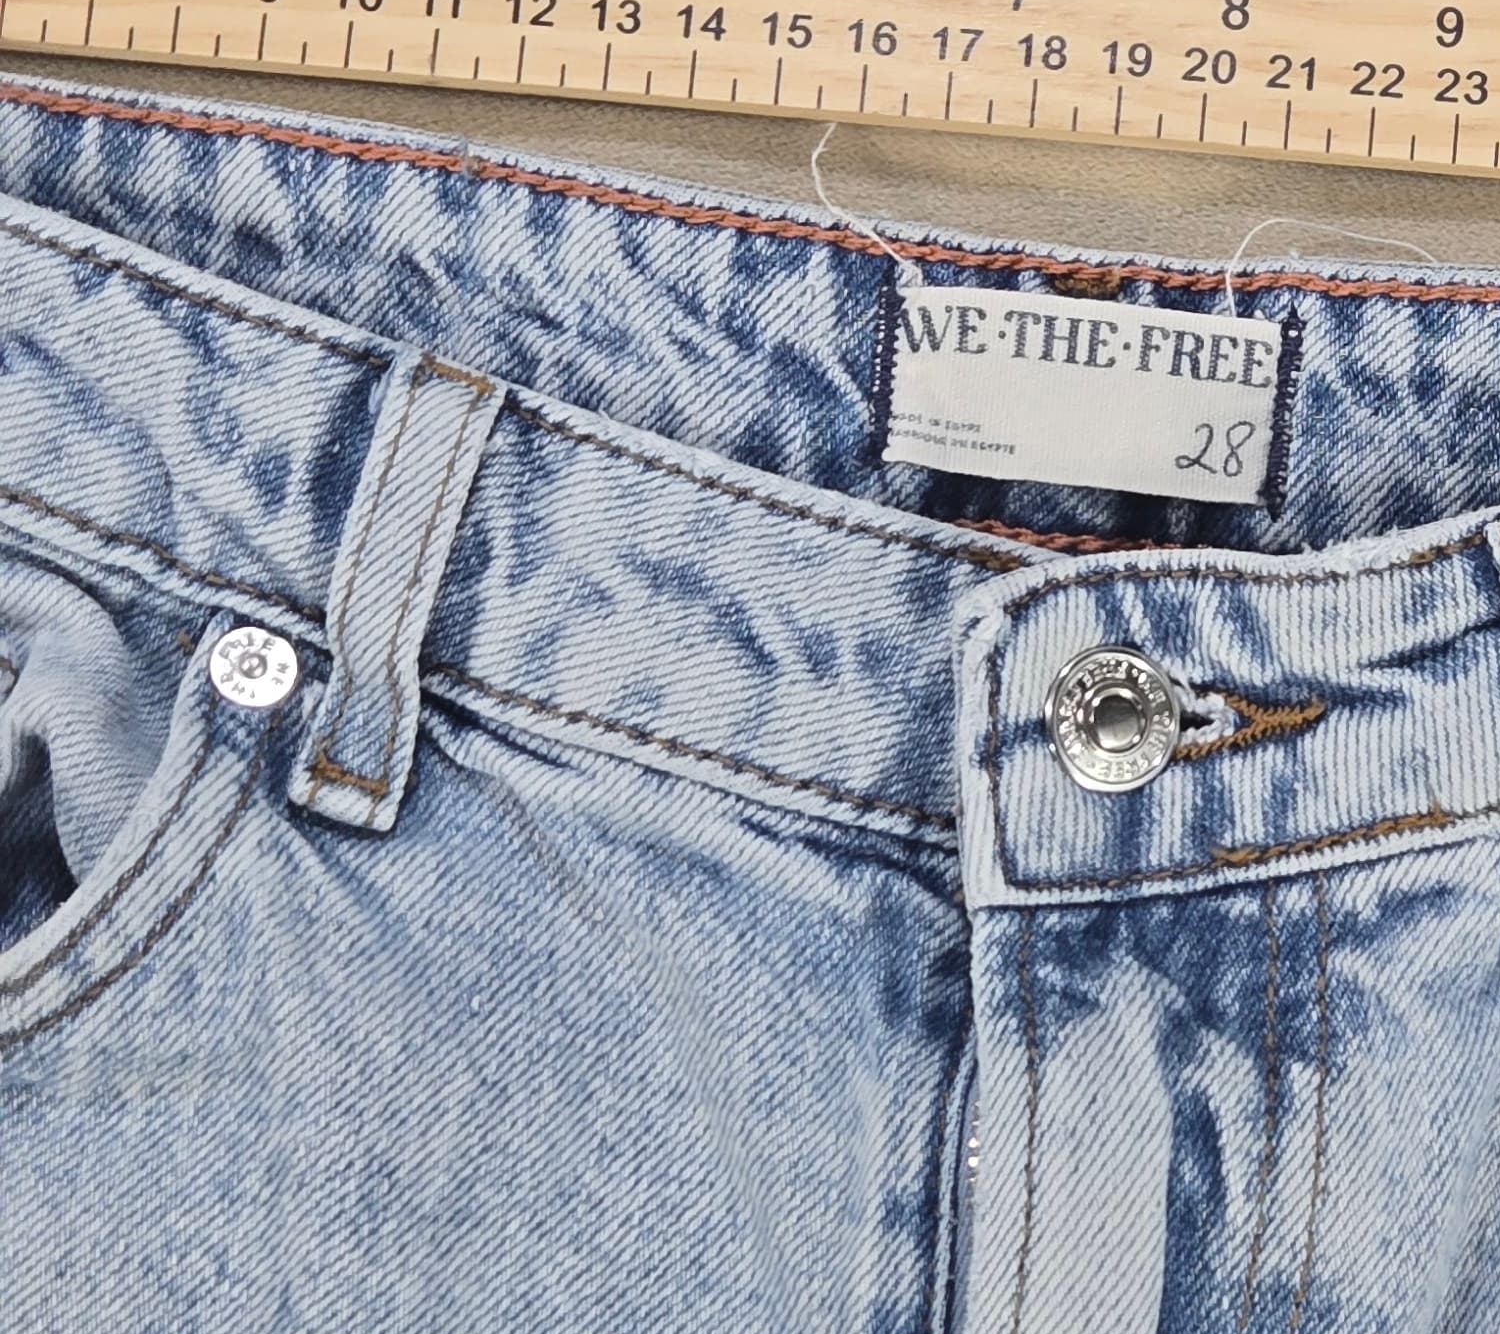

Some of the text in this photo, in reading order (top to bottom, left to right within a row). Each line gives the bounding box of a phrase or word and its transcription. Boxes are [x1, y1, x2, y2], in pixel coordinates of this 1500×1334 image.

[676, 4, 727, 42] 14
[762, 11, 813, 49] 15
[847, 18, 898, 56] 16
[932, 26, 985, 62] 17
[1017, 33, 1067, 71] 18
[1102, 40, 1153, 78] 19
[1181, 47, 1237, 85] 20
[1265, 54, 1316, 92] 21
[1349, 60, 1406, 99] 22
[1433, 67, 1489, 106] 23
[1435, 6, 1465, 49] 9
[1175, 421, 1257, 477] 28
